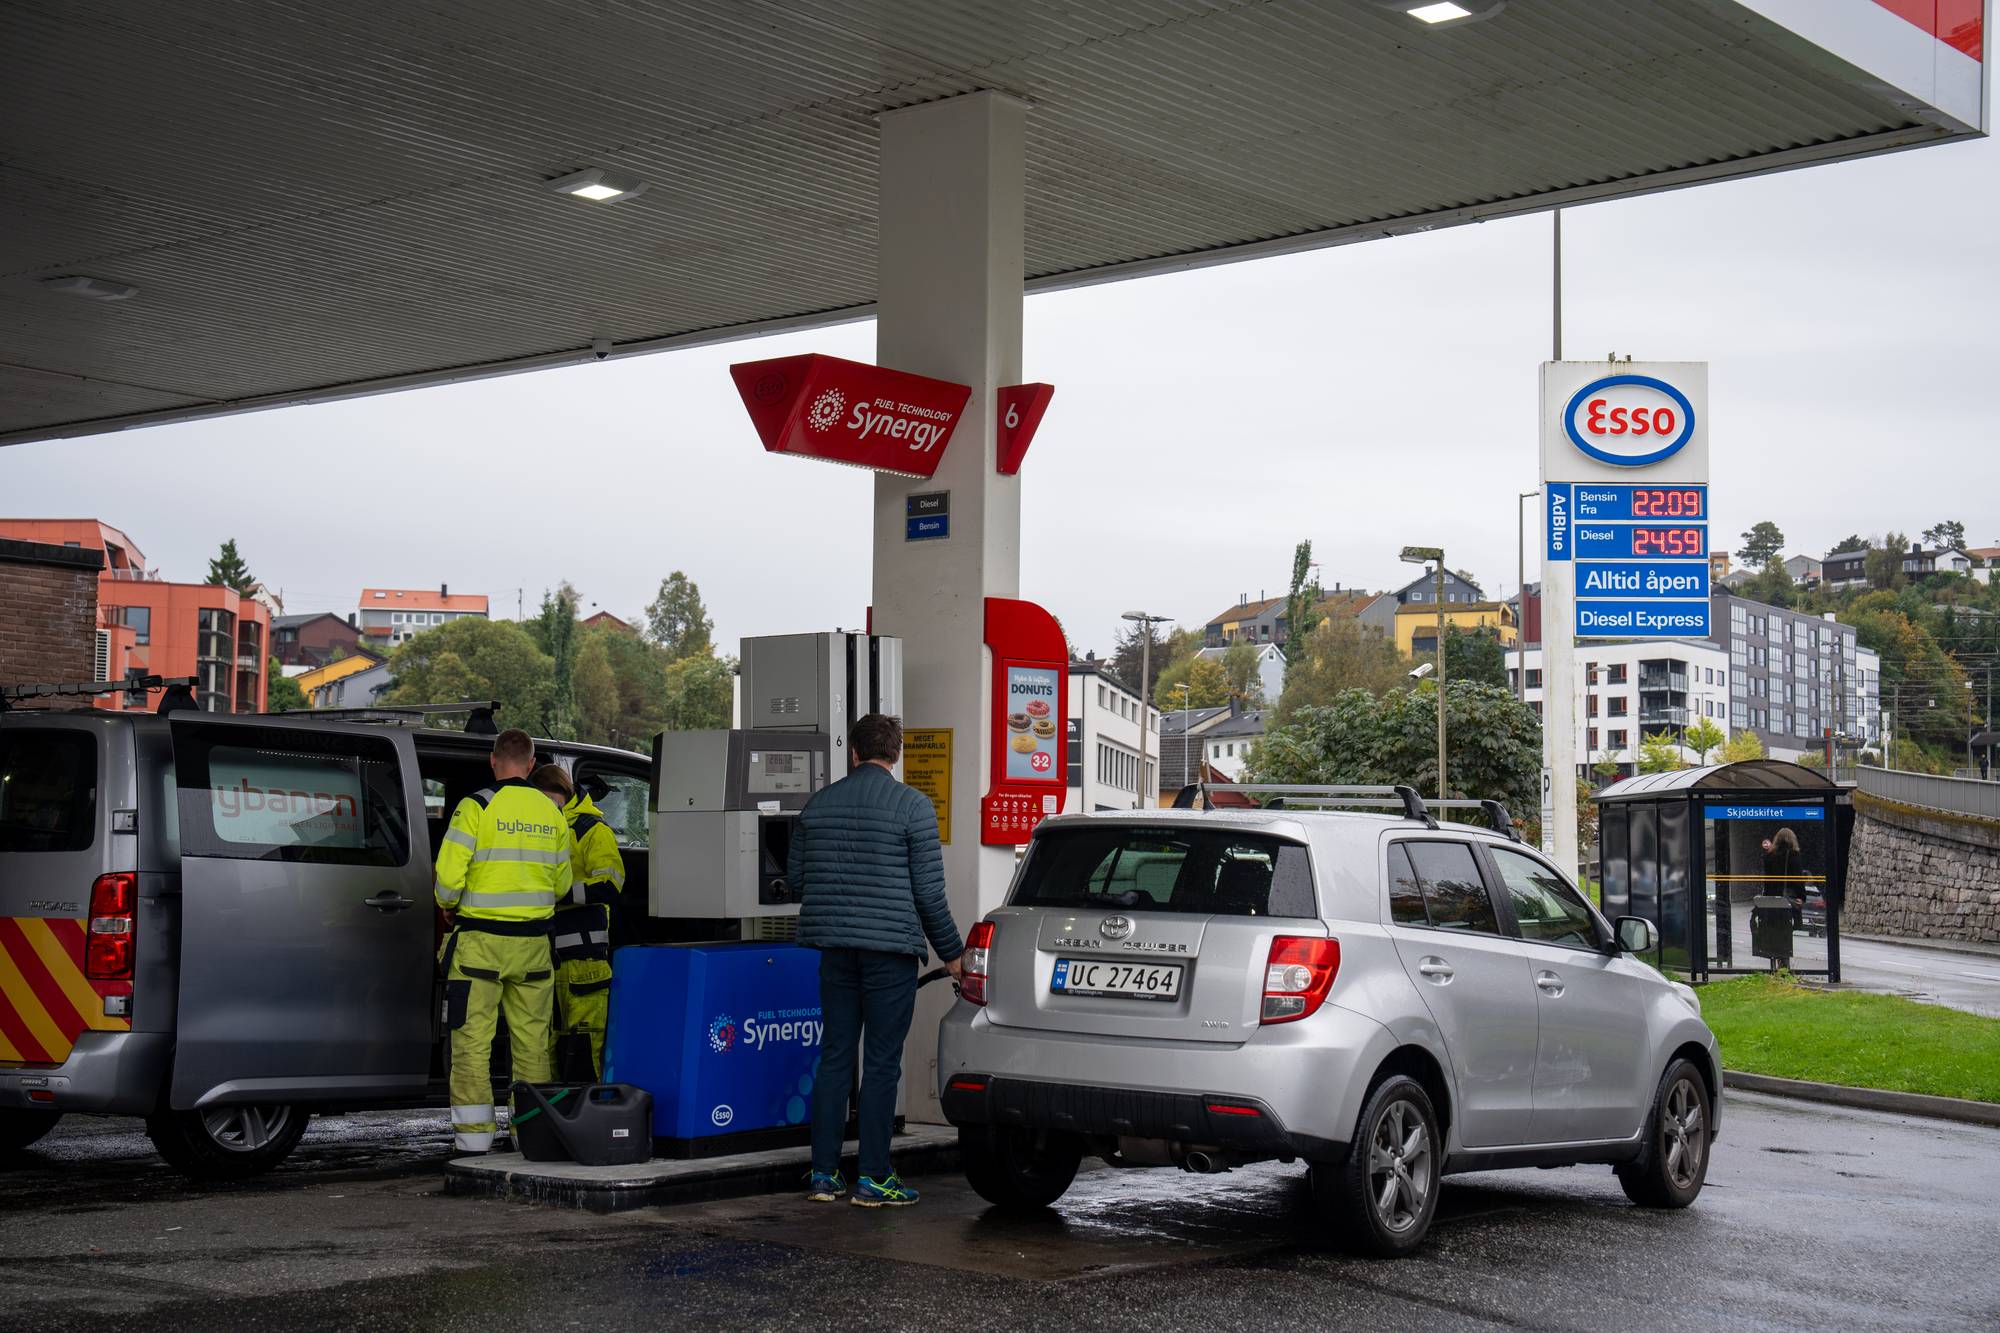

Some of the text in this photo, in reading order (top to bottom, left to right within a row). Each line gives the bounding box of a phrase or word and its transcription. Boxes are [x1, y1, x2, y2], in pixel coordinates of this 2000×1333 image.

[874, 398, 952, 421] FUEL TECHNOLOGY
[1005, 403, 1018, 428] 6
[847, 402, 946, 452] Synergy
[920, 499, 939, 508] Diesel
[1580, 491, 1699, 516] Bensin 22.09
[1580, 505, 1597, 515] Fra
[919, 522, 940, 530] Bensin
[1552, 494, 1566, 551] AdBlue
[1581, 529, 1699, 554] Diesel 24.59
[1584, 571, 1700, 594] Alltid åpen
[1580, 611, 1704, 630] Diesel Express
[1011, 684, 1053, 695] DONUTS
[836, 735, 842, 747] 6
[217, 778, 357, 818] ybanen
[1544, 774, 1550, 804] P
[1727, 808, 1784, 819] Skjoldskiftet
[496, 818, 559, 835] bybanen
[1071, 965, 1173, 992] UC 27464
[758, 1008, 822, 1019] FUEL TECHNOLOG
[743, 1018, 824, 1051] Synergy
